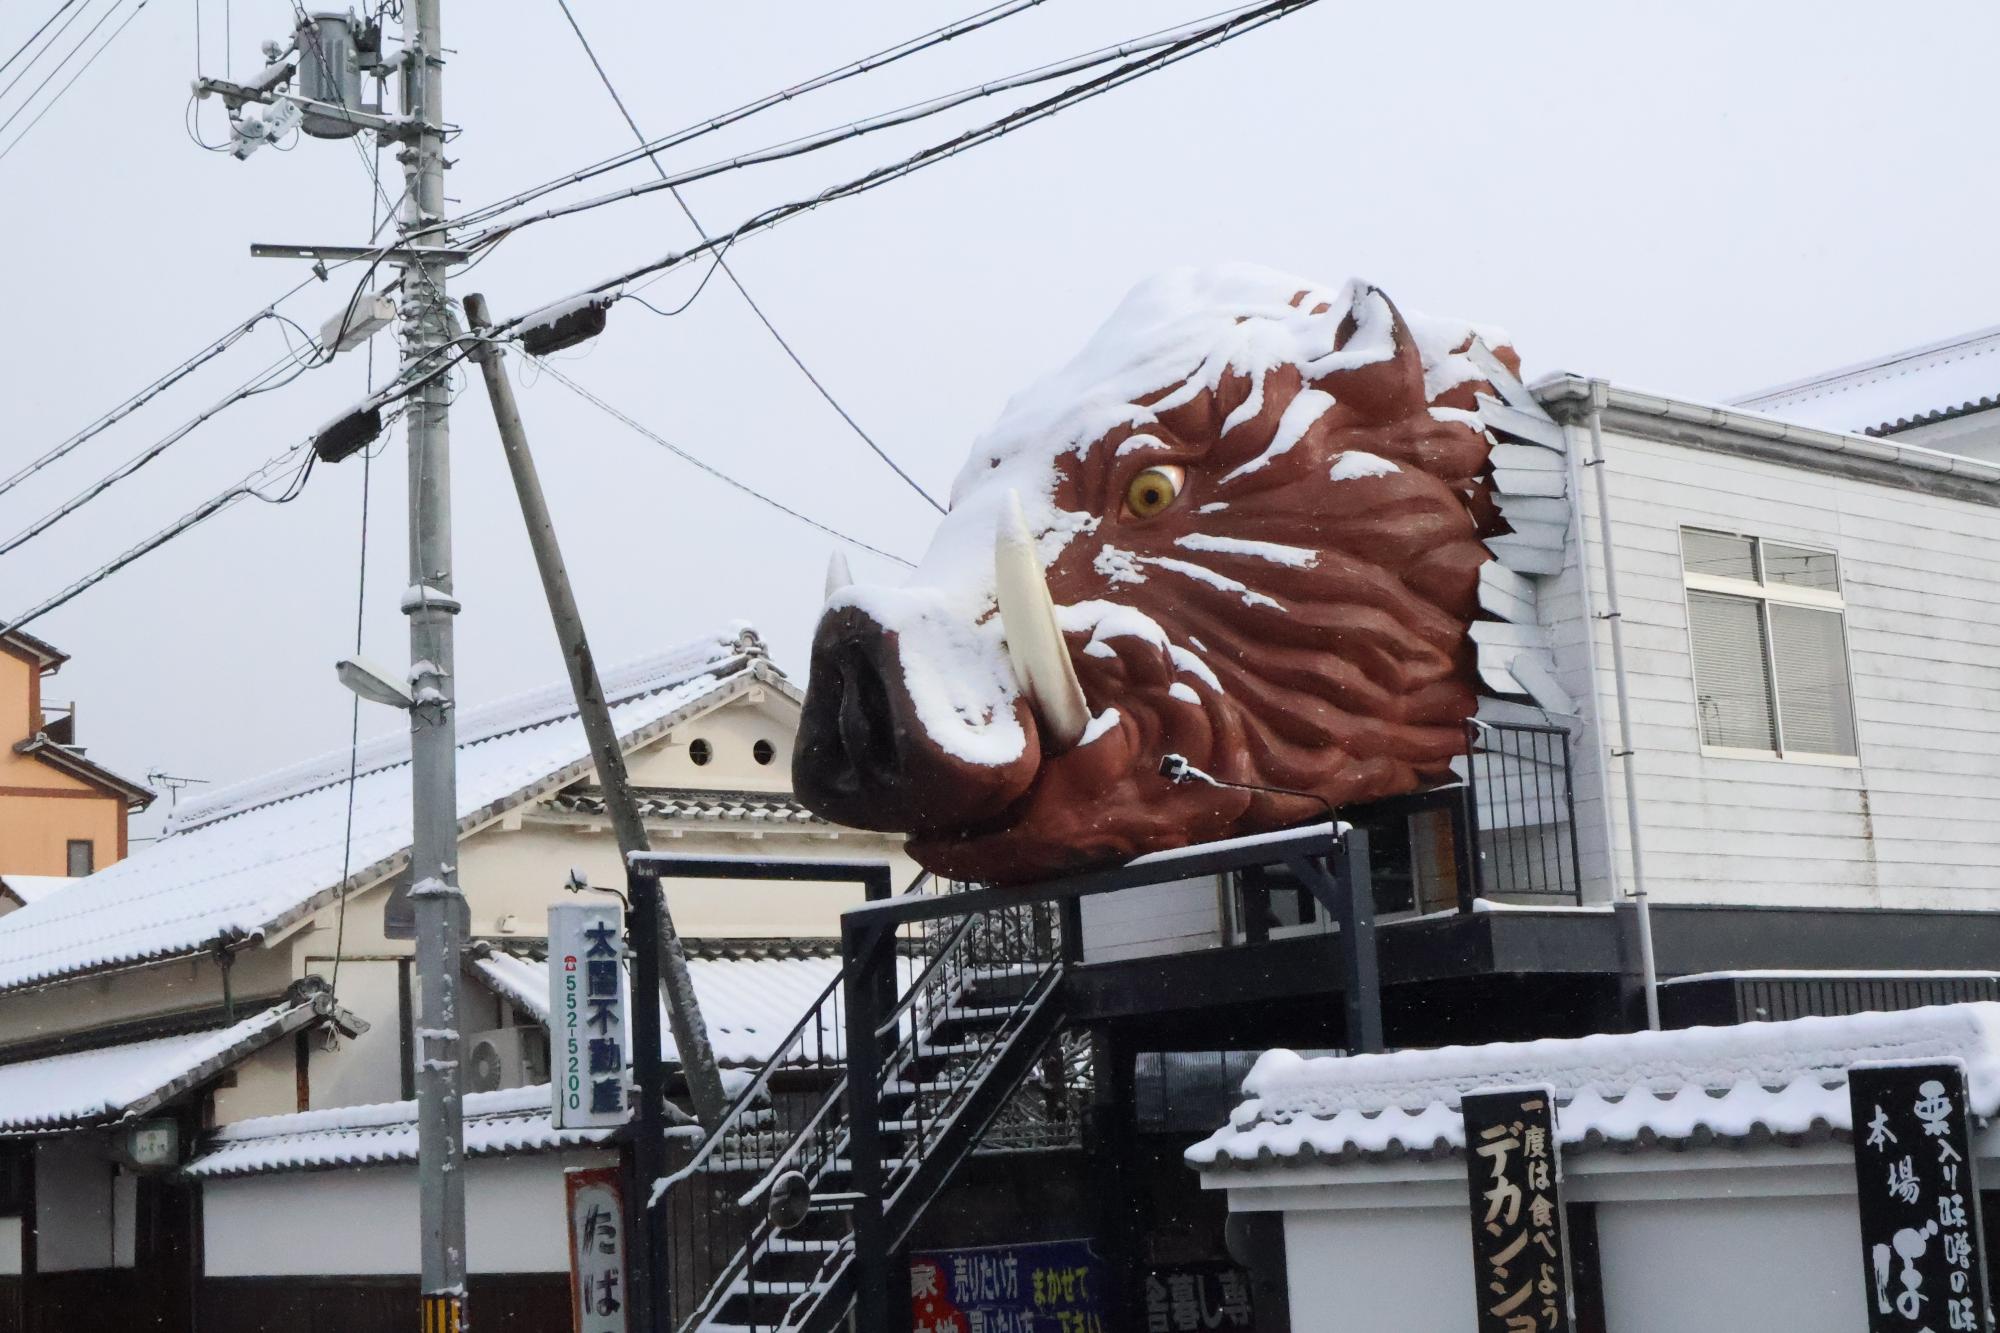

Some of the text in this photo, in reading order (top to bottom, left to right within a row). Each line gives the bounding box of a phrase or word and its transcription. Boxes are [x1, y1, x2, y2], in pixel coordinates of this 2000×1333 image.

[566, 974, 580, 1110] 552-5200
[583, 1204, 621, 1333] たば
[953, 1251, 1088, 1307] 売りたい方 まかせて
[1520, 1099, 1558, 1330] 一度は食べよう
